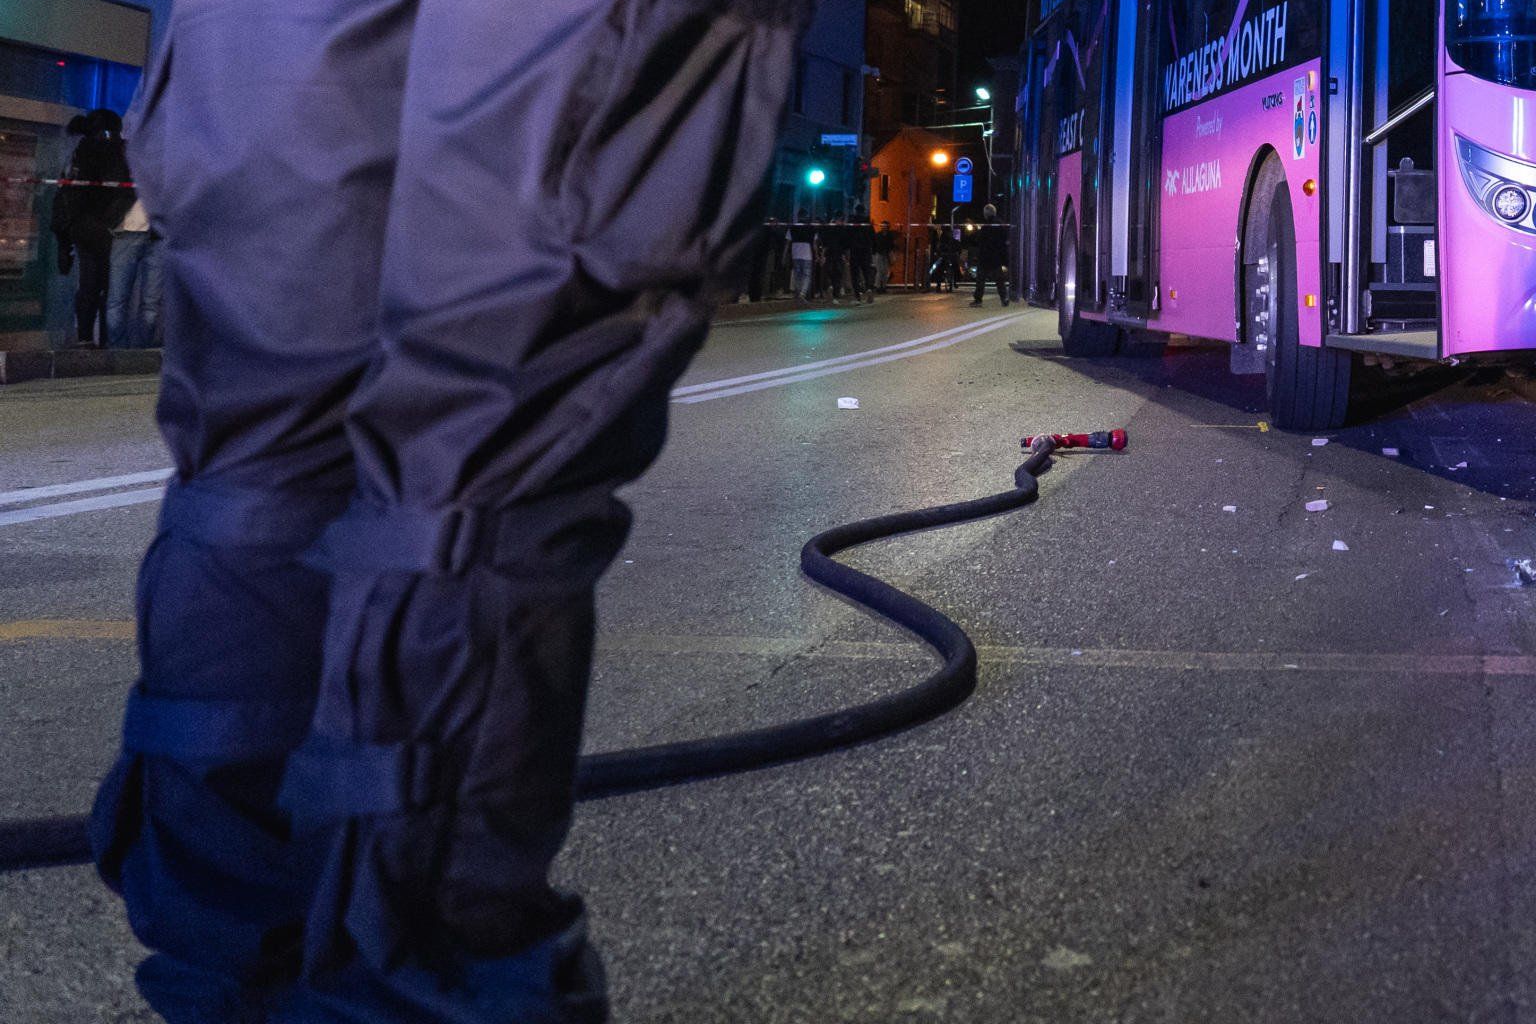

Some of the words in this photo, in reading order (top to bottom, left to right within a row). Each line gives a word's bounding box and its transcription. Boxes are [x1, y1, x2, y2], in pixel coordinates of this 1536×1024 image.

[1226, 0, 1288, 87] MONTH
[960, 179, 967, 189] P
[1181, 159, 1221, 195] ALILAGUNA
